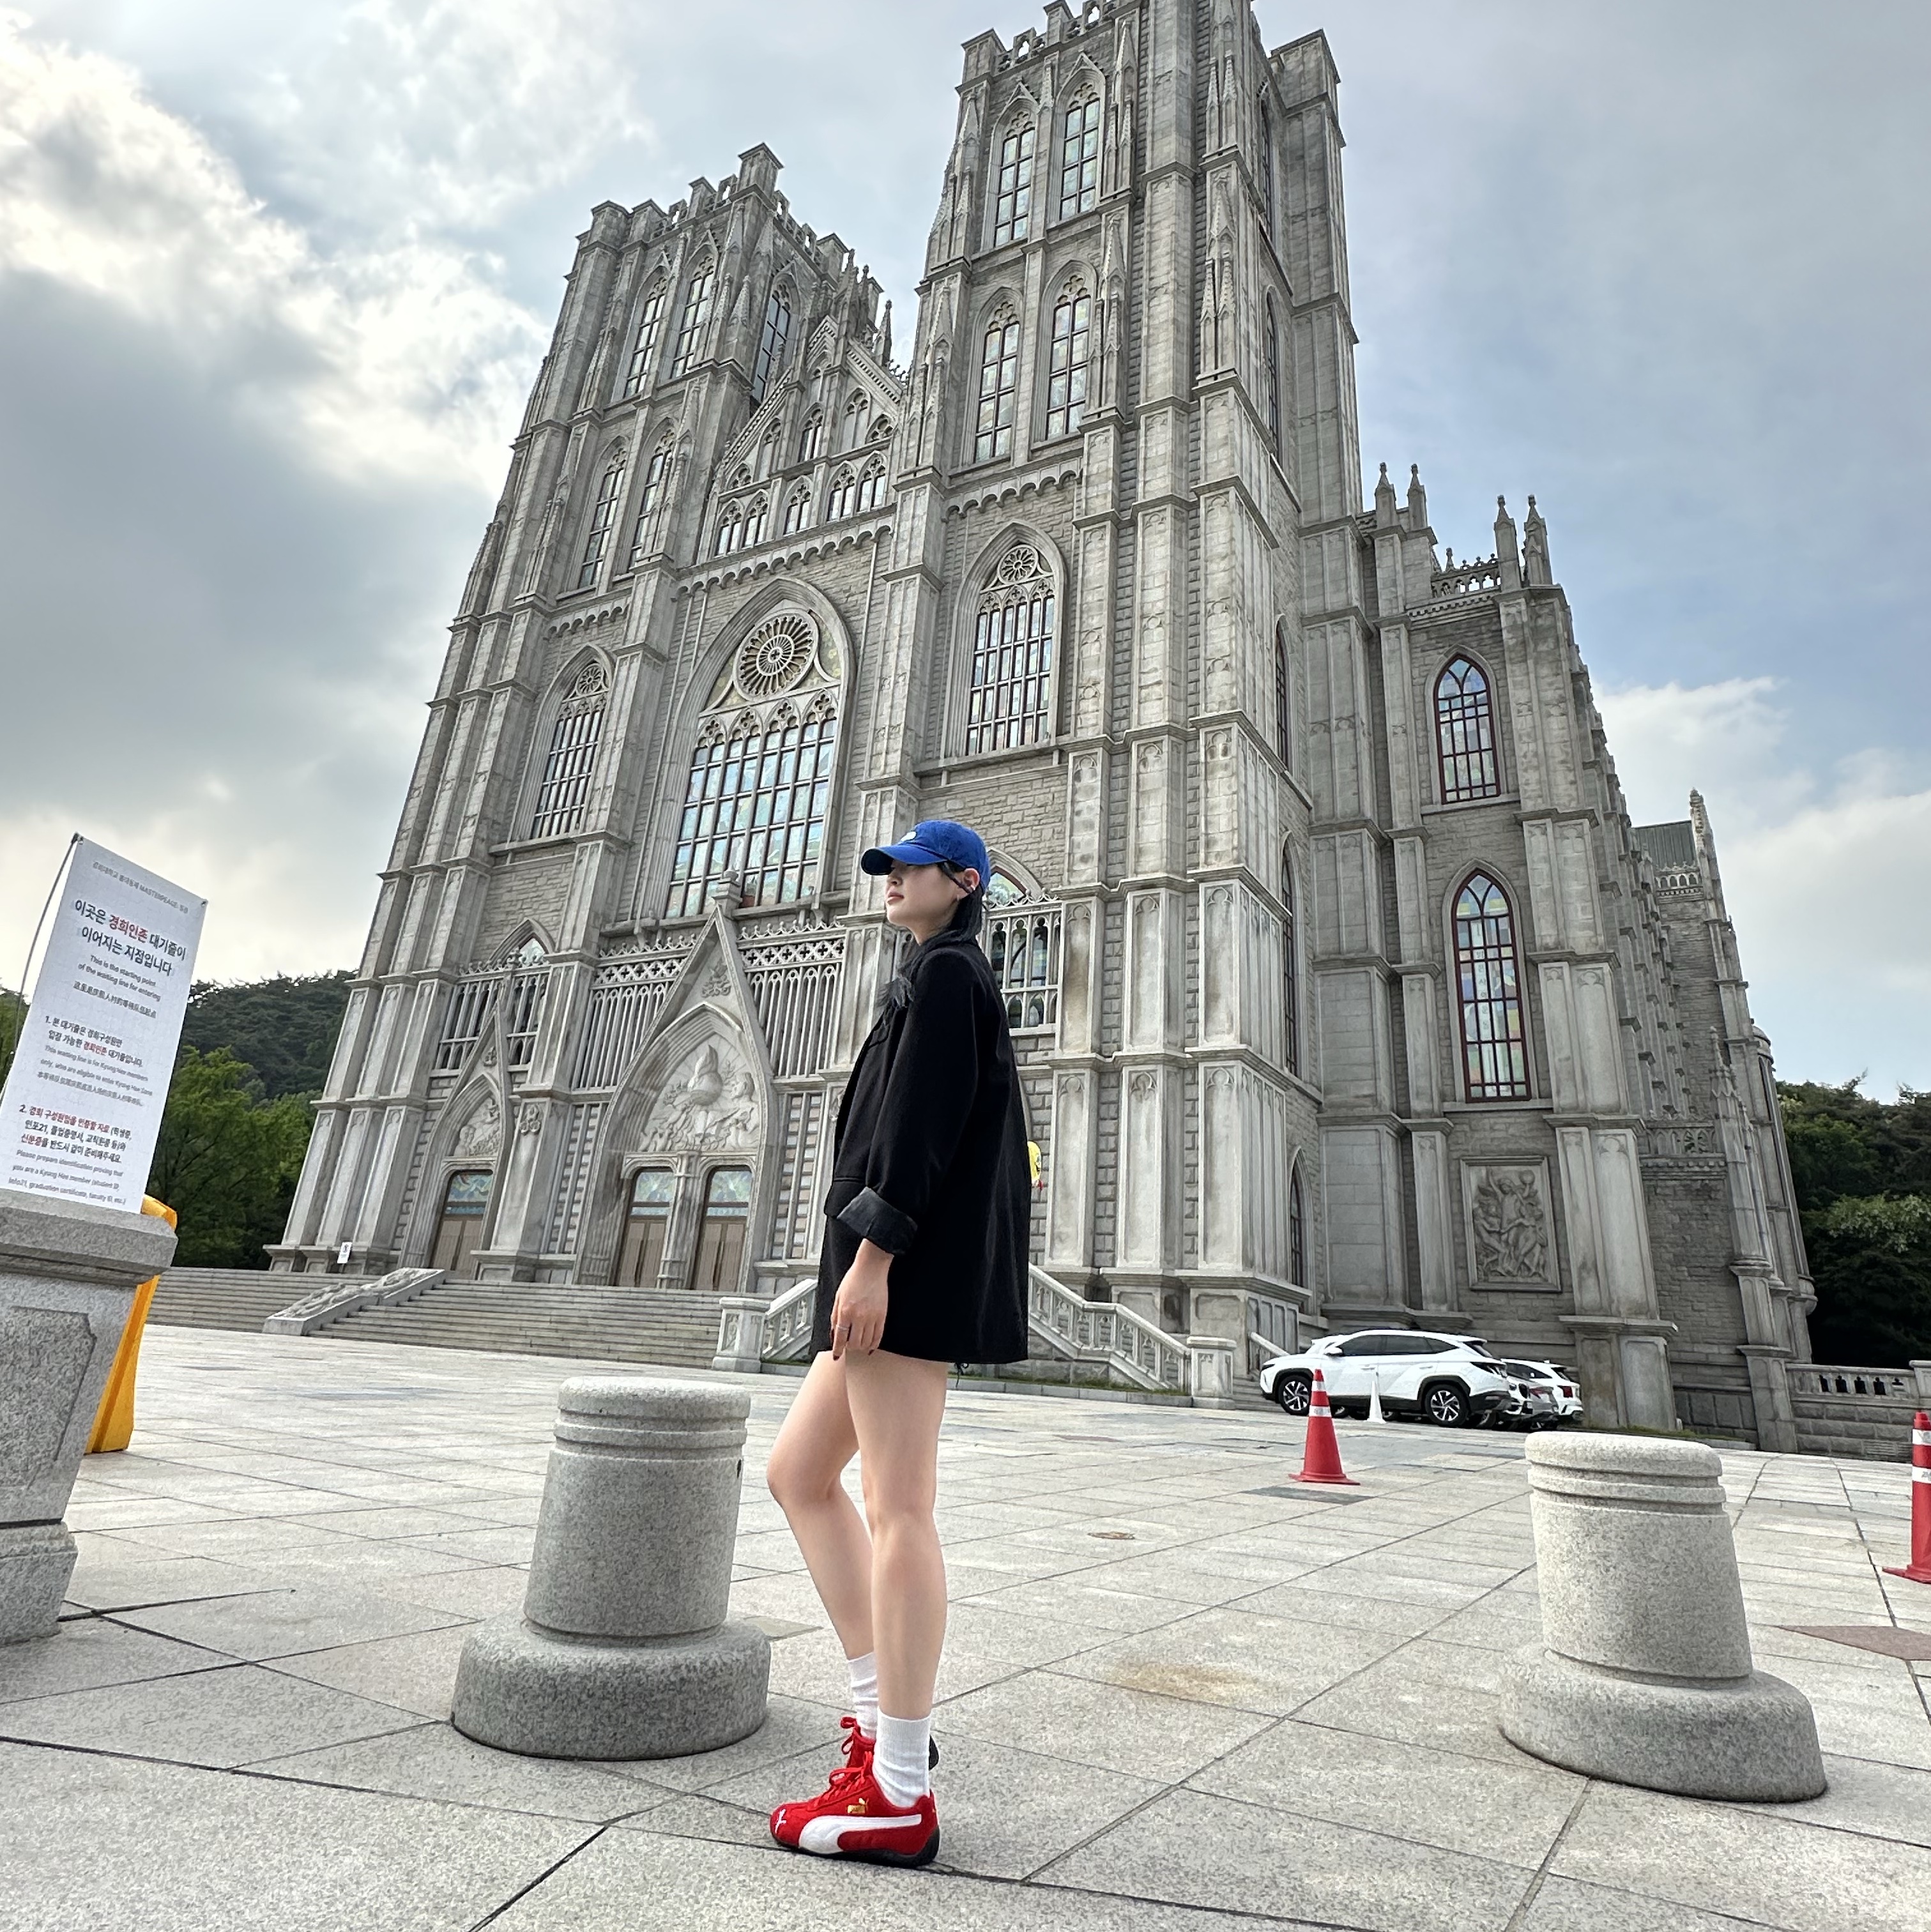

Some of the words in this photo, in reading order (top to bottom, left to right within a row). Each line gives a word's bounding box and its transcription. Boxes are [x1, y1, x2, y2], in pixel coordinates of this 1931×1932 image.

[75, 901, 105, 925] 이곳은
[109, 915, 147, 943] 경희인존
[149, 934, 185, 961] 대기줄이
[82, 927, 122, 955] 이어지는
[125, 945, 171, 976] 지점입니다
